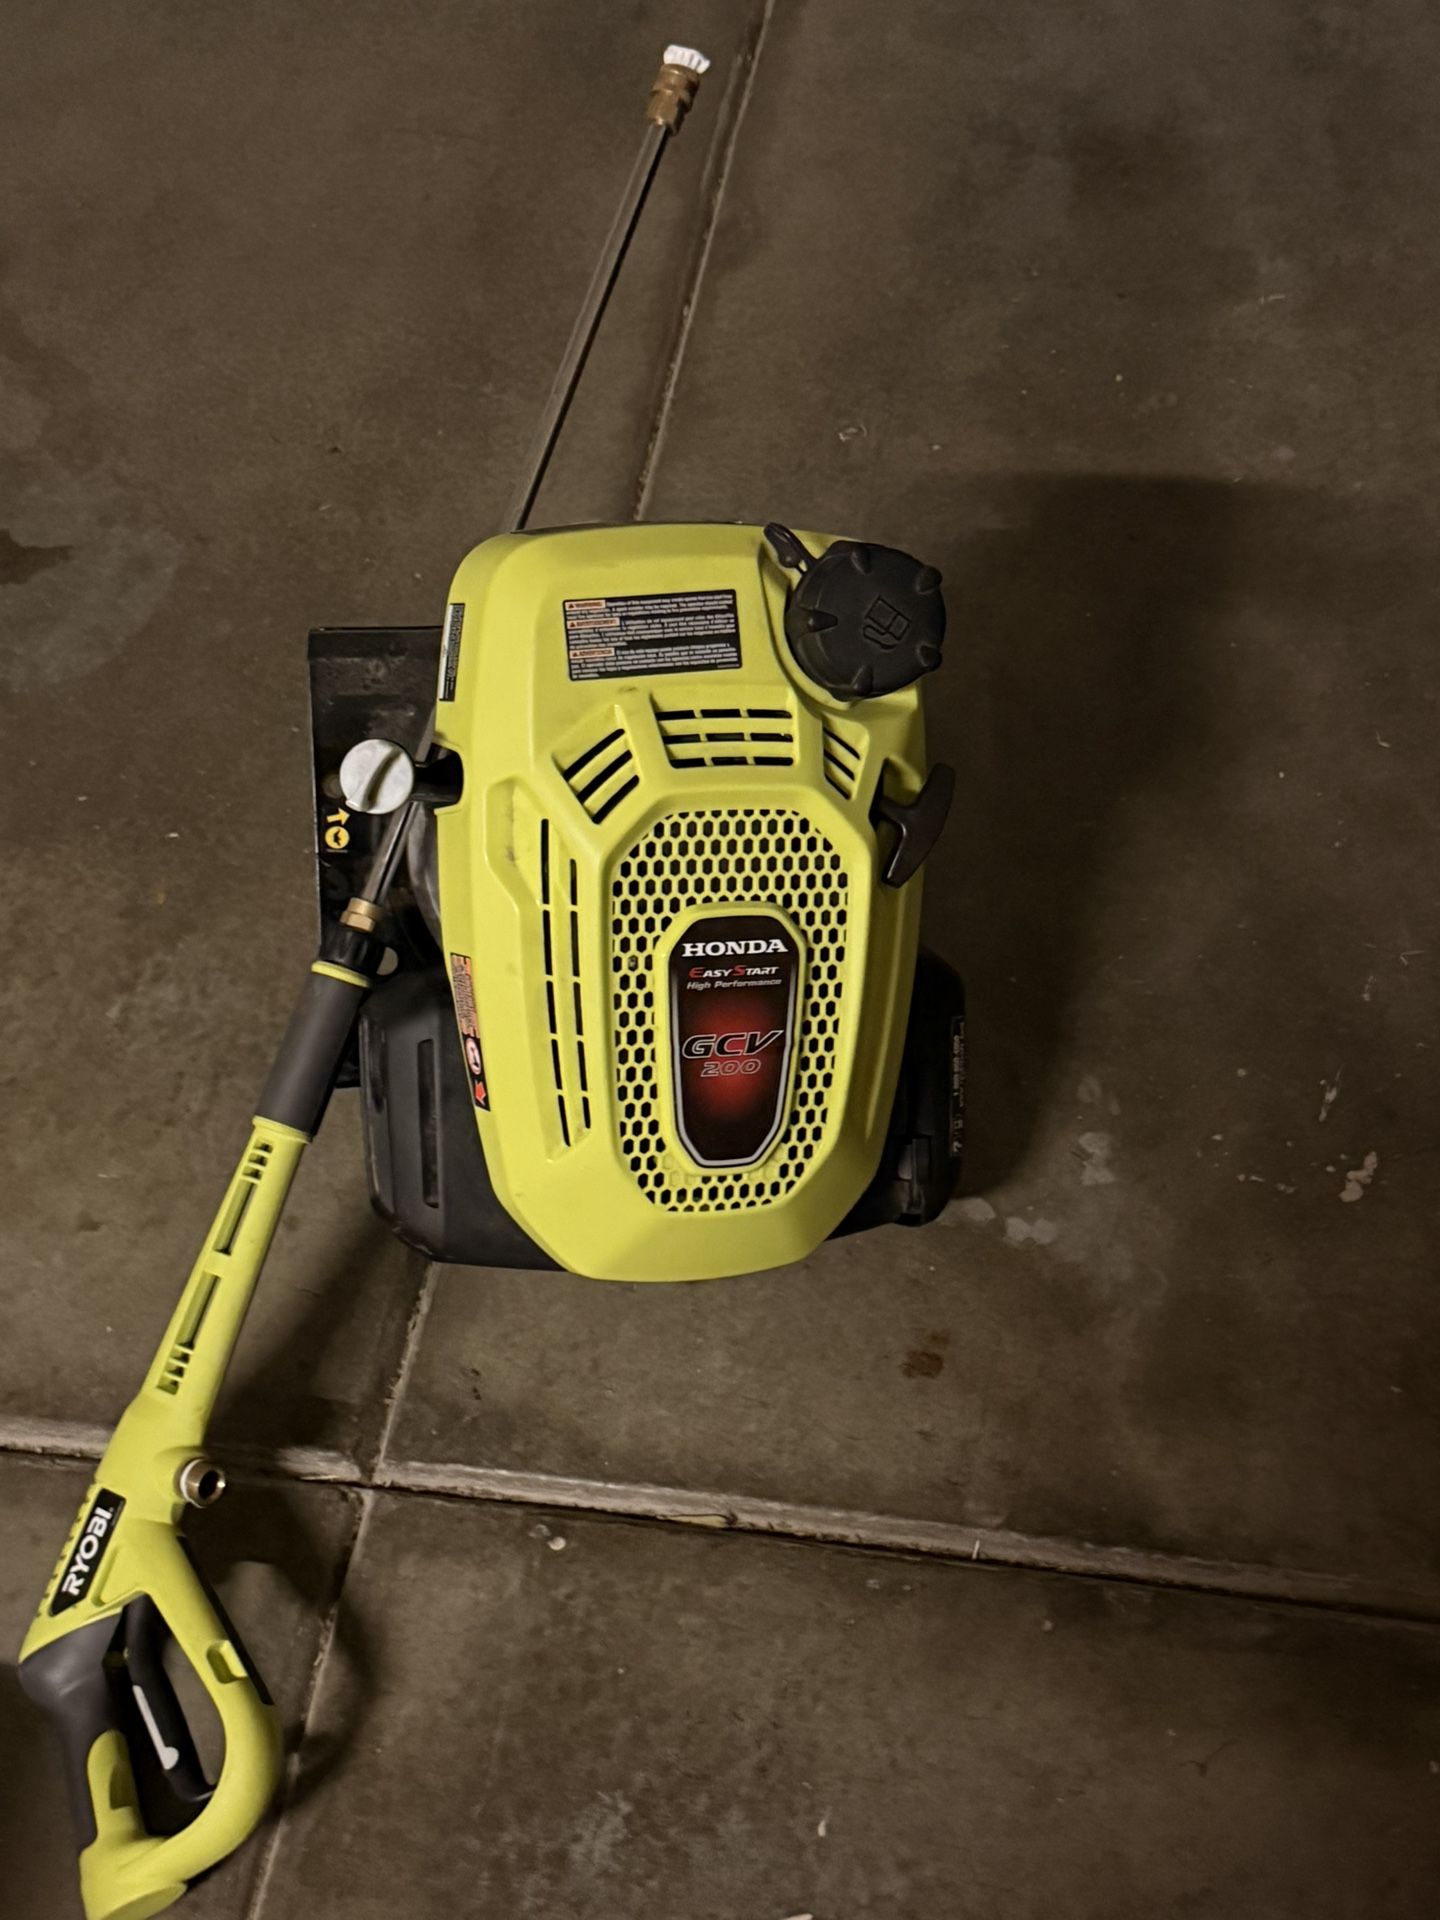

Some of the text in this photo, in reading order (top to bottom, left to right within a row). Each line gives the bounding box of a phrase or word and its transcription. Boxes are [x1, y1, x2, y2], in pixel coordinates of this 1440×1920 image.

[681, 939, 788, 957] HONDA
[686, 979, 782, 991] High Performance
[682, 1029, 784, 1059] GCV
[700, 1058, 761, 1077] 200
[61, 1506, 113, 1596] RYOBI
